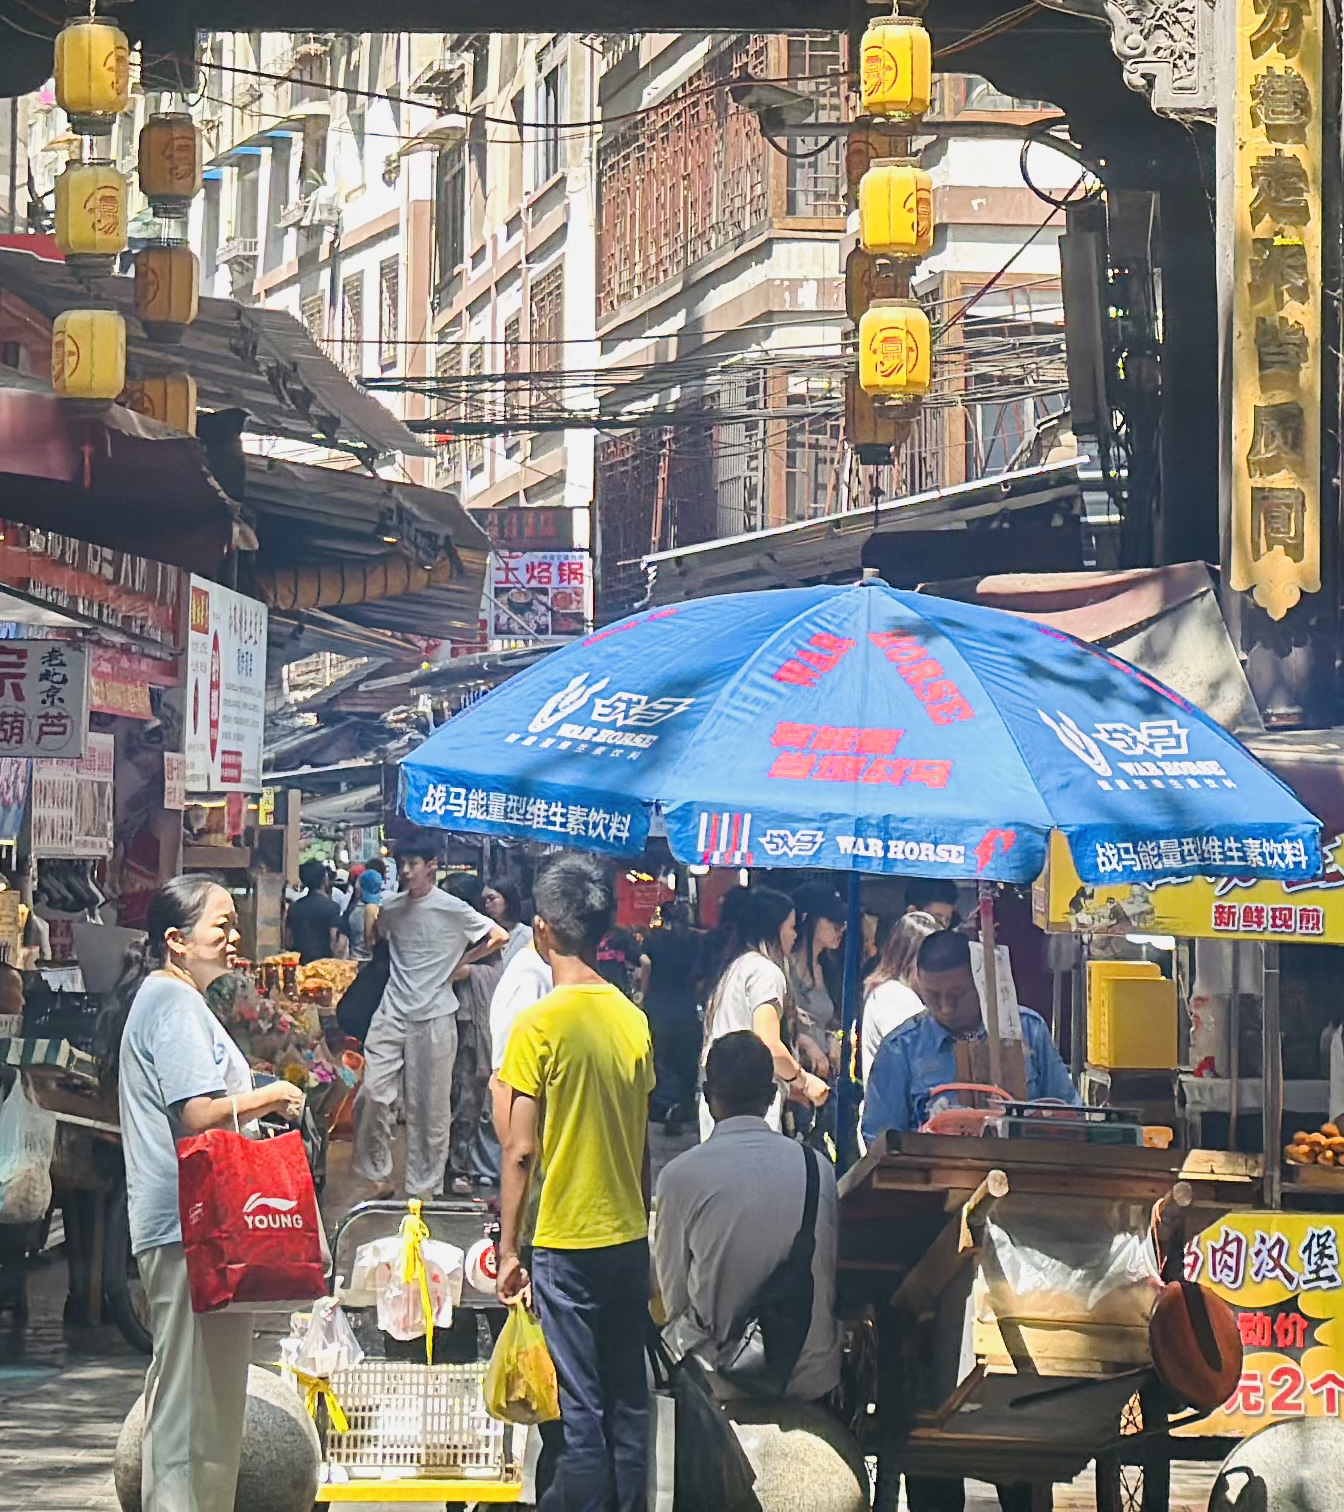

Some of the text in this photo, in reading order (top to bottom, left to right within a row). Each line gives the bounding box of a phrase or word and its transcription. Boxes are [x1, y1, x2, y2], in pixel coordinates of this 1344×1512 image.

[495, 561, 584, 585] 土烙锅
[38, 646, 68, 706] 老北京
[422, 784, 630, 843] 战马能量型维生素饮料
[837, 837, 964, 864] WAR HORSE
[1097, 837, 1308, 873] 战马能量型维生素饮料
[1212, 903, 1324, 934] 新鲜现煎
[244, 1213, 303, 1229] YOUNG
